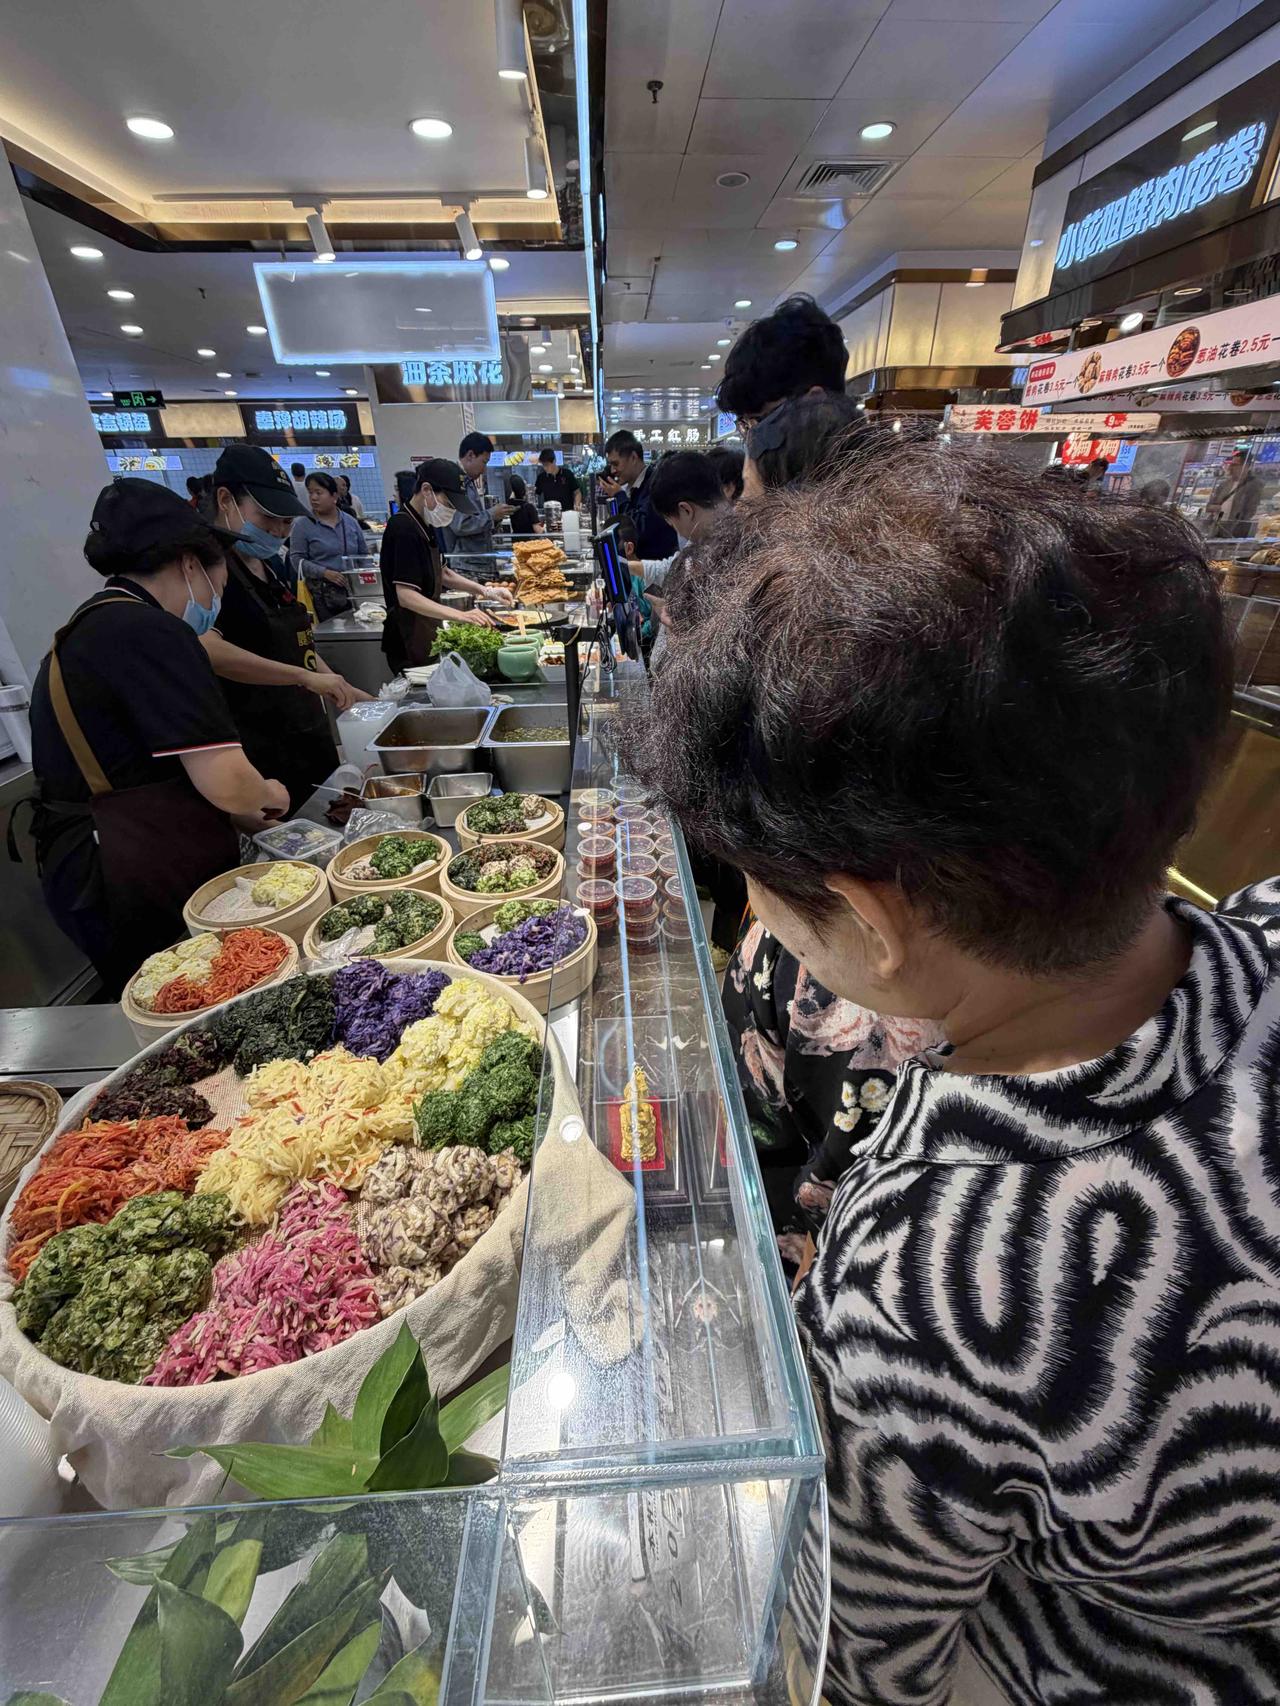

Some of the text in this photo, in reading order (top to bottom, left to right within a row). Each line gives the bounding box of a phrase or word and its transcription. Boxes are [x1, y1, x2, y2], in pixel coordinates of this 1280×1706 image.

[1056, 121, 1267, 270] 小花姐鲜肉花卷
[974, 409, 1039, 430] 芙蓉饼
